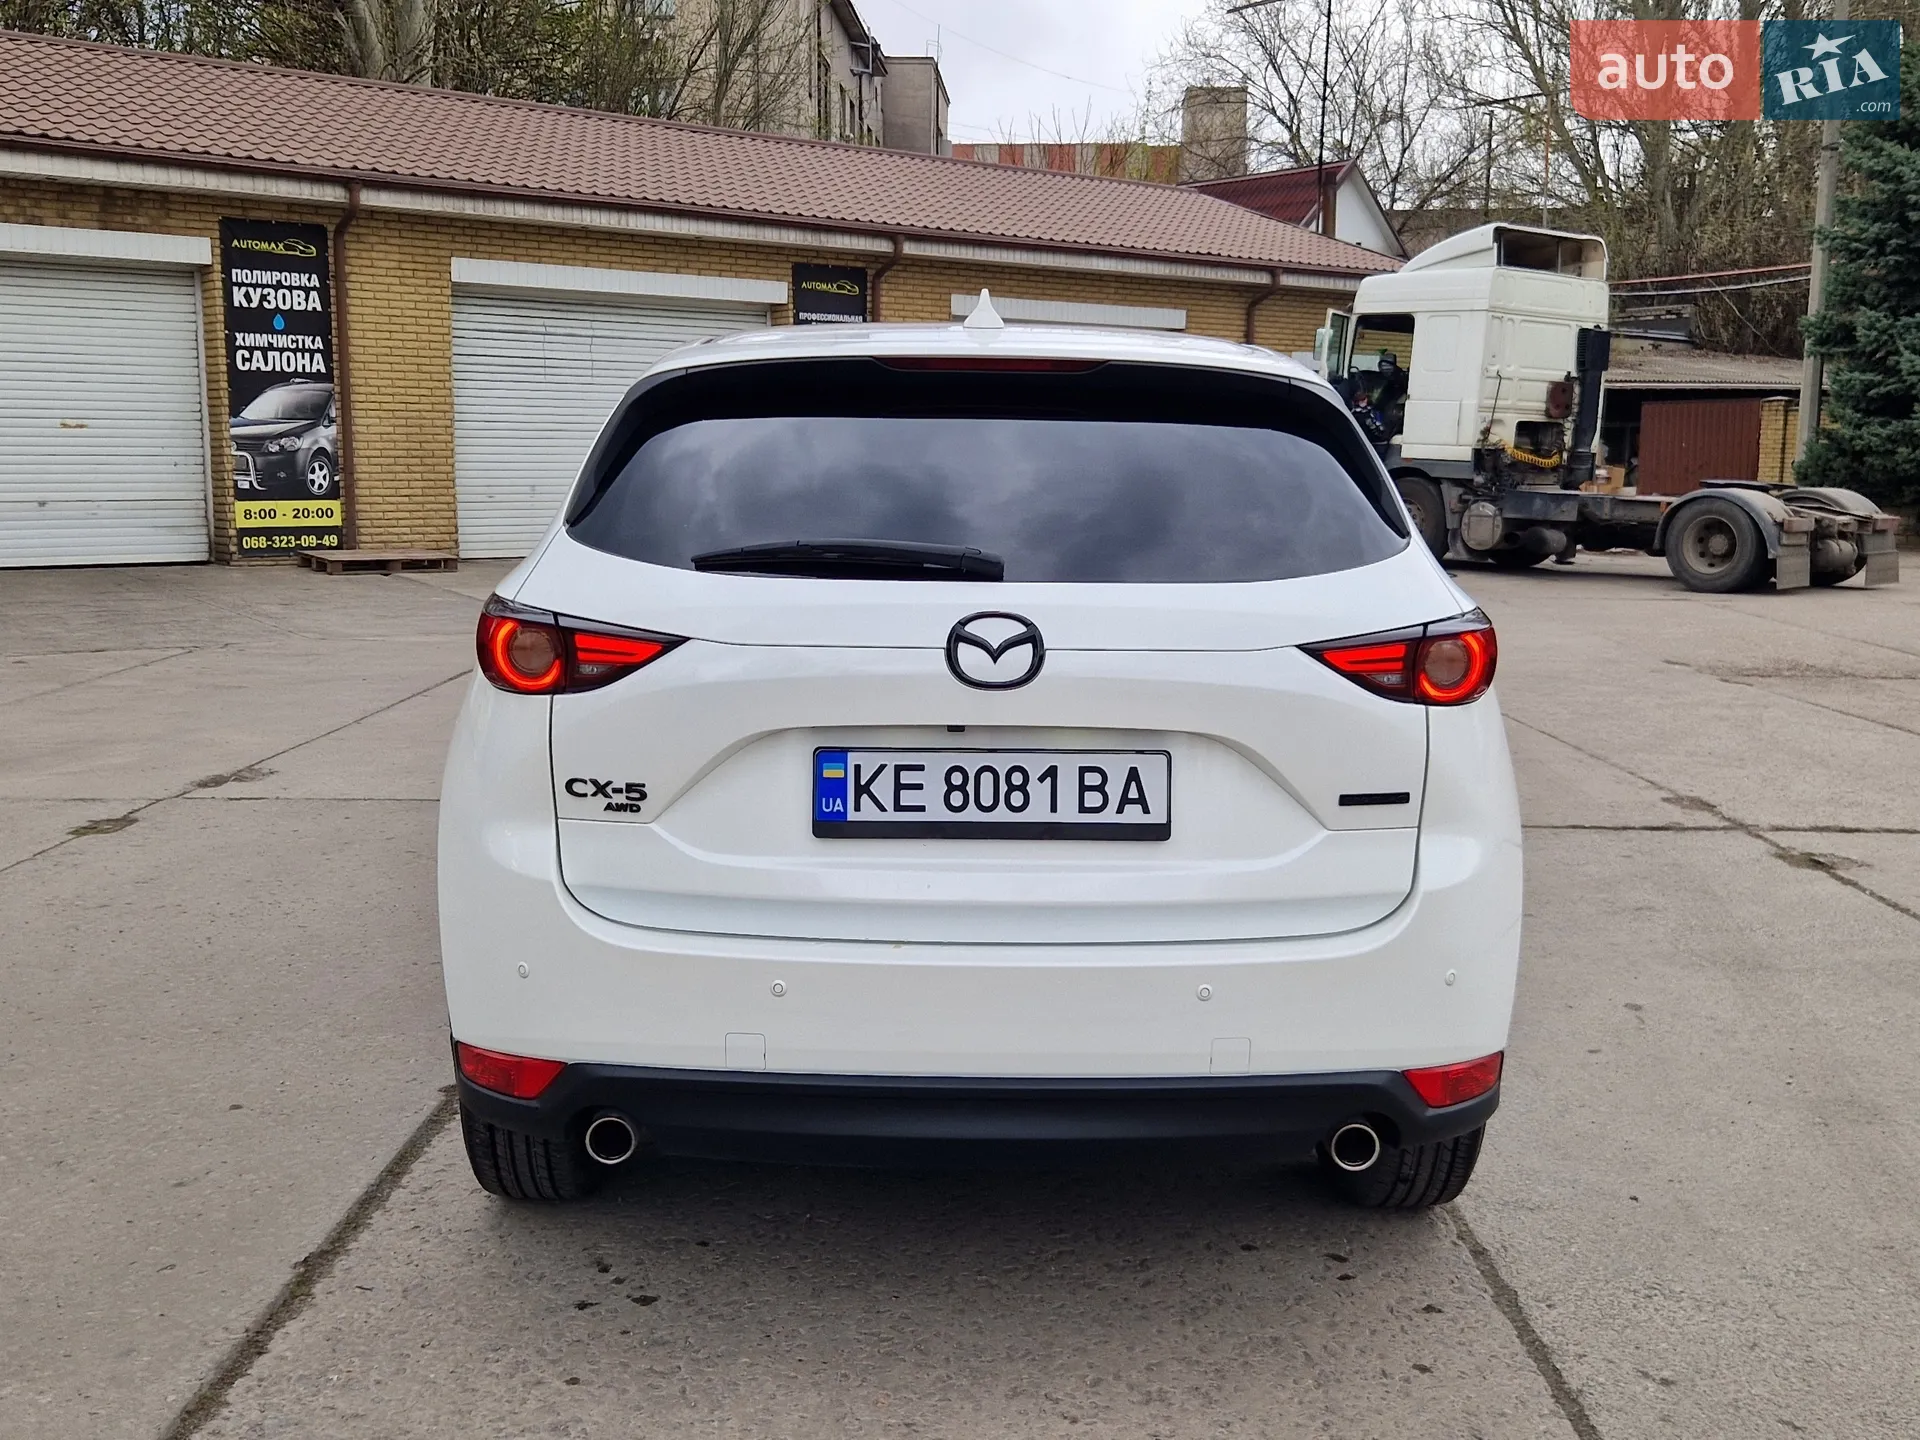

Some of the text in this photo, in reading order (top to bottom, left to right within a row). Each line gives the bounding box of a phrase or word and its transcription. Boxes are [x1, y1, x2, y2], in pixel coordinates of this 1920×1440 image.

[231, 238, 285, 252] AUTOMAX
[231, 268, 320, 288] ПОЛИРОВКА
[801, 281, 837, 291] AUTOMAX
[232, 286, 322, 312] КУЗОВА
[799, 312, 863, 323] ПРОФЕССИОНАЛЬНАЯ
[234, 332, 324, 350] ХИМЧИСТКА
[235, 350, 327, 374] САЛОНА
[243, 508, 277, 520] 8:00
[292, 507, 334, 519] 20:00
[242, 534, 338, 549] 068-323-09-49
[564, 777, 648, 802] CX-5
[853, 763, 1151, 815] KE 8081 BA
[603, 802, 642, 813] AWD
[822, 797, 844, 813] UA
